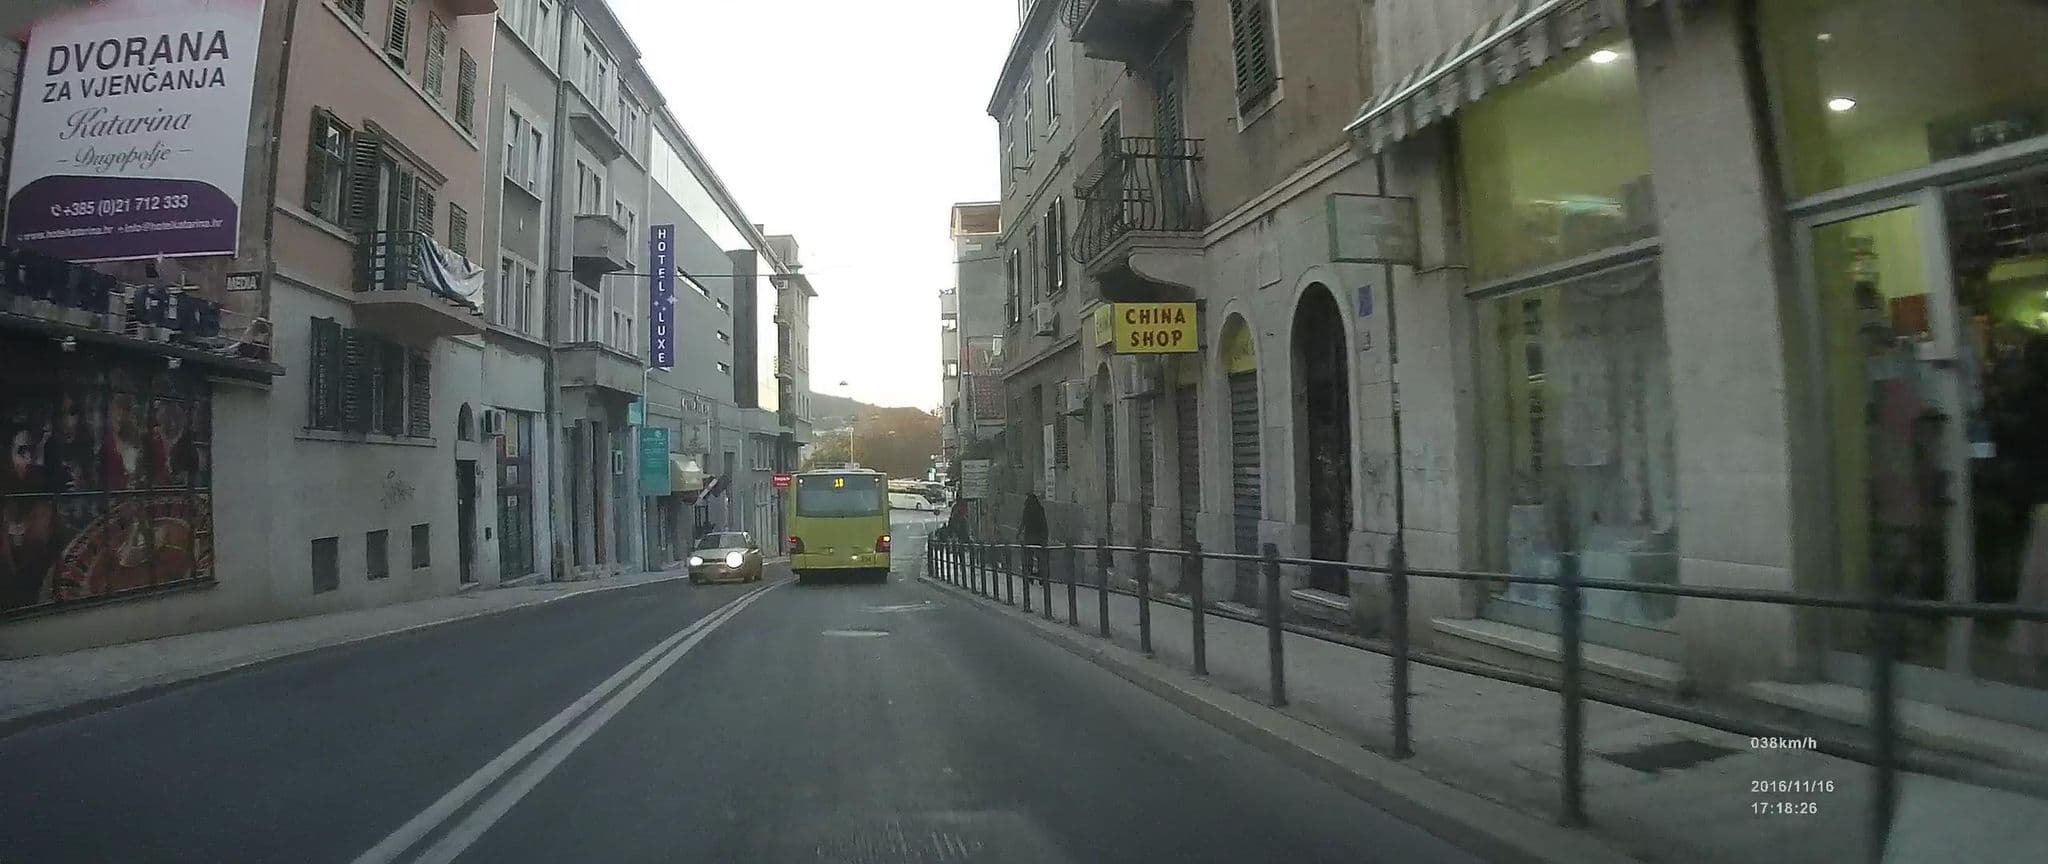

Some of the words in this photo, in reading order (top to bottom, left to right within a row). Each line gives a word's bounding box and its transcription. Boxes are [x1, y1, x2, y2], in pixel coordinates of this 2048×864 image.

[47, 30, 229, 76] DVORANA
[43, 83, 71, 103] ZA
[81, 67, 226, 99] VJENČANJA
[59, 107, 192, 140] Katarina
[63, 201, 95, 217] +385
[98, 198, 130, 217] (0)21
[135, 197, 160, 211] 712
[164, 195, 189, 209] 333
[657, 229, 667, 292] HOTEL
[227, 276, 257, 291] MEDIA
[1125, 308, 1186, 325] CHINA
[657, 312, 667, 364] LUXE
[1130, 330, 1184, 347] SHOP
